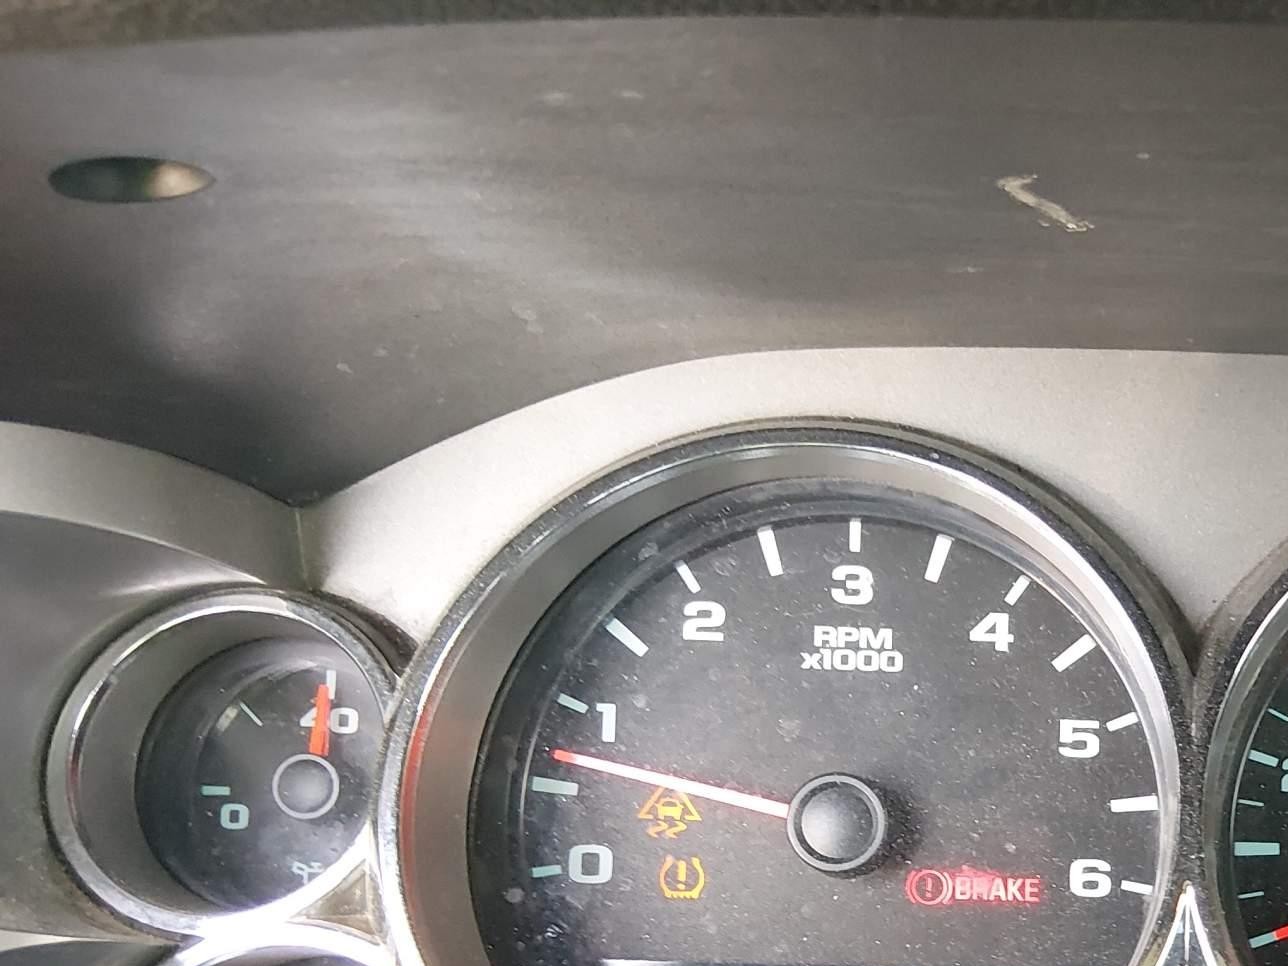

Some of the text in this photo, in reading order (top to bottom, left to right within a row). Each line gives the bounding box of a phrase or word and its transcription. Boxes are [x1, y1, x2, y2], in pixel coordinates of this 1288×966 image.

[830, 564, 874, 605] 3
[681, 601, 727, 642] 2
[813, 625, 893, 650] RPM
[968, 612, 1014, 652] 4
[800, 651, 903, 673] x1000
[595, 702, 617, 743] 1
[1057, 719, 1100, 759] 5
[220, 803, 249, 830] 0
[568, 844, 614, 884] 0
[1069, 858, 1112, 897] 6
[955, 876, 1041, 902] BRAKE
